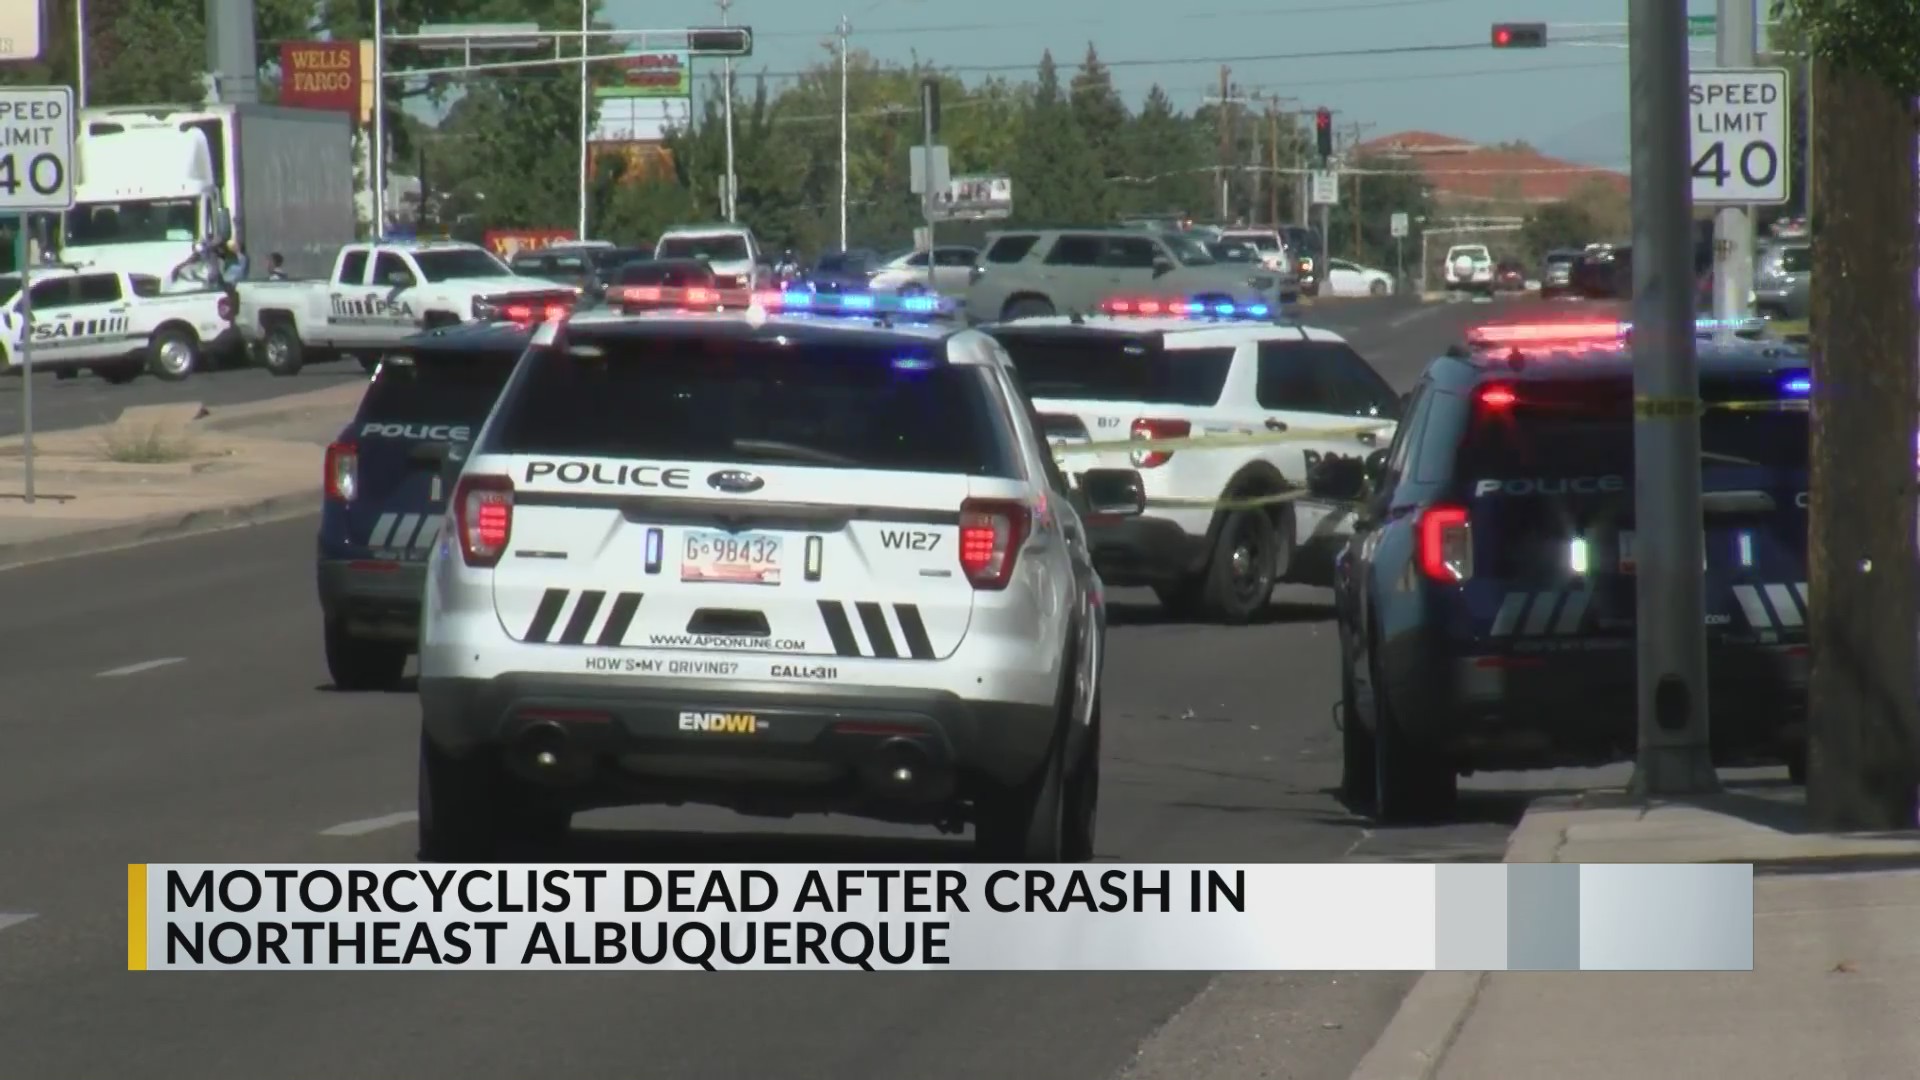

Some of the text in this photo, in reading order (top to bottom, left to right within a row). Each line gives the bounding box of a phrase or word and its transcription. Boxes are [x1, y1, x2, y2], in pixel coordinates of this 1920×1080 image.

[291, 50, 350, 69] WELLS
[293, 71, 350, 92] FARGO
[1688, 83, 1778, 105] SPEED
[0, 101, 62, 120] PEED
[1697, 112, 1768, 133] LIMIT
[0, 127, 54, 147] IMIT
[0, 152, 64, 196] 40
[1690, 140, 1778, 188] 40
[360, 422, 471, 441] POLICE
[525, 461, 691, 489] POLICE
[1475, 474, 1625, 498] POLICE
[648, 633, 806, 650] WWW.APDONLINE.COM
[669, 660, 739, 675] DRIVING?
